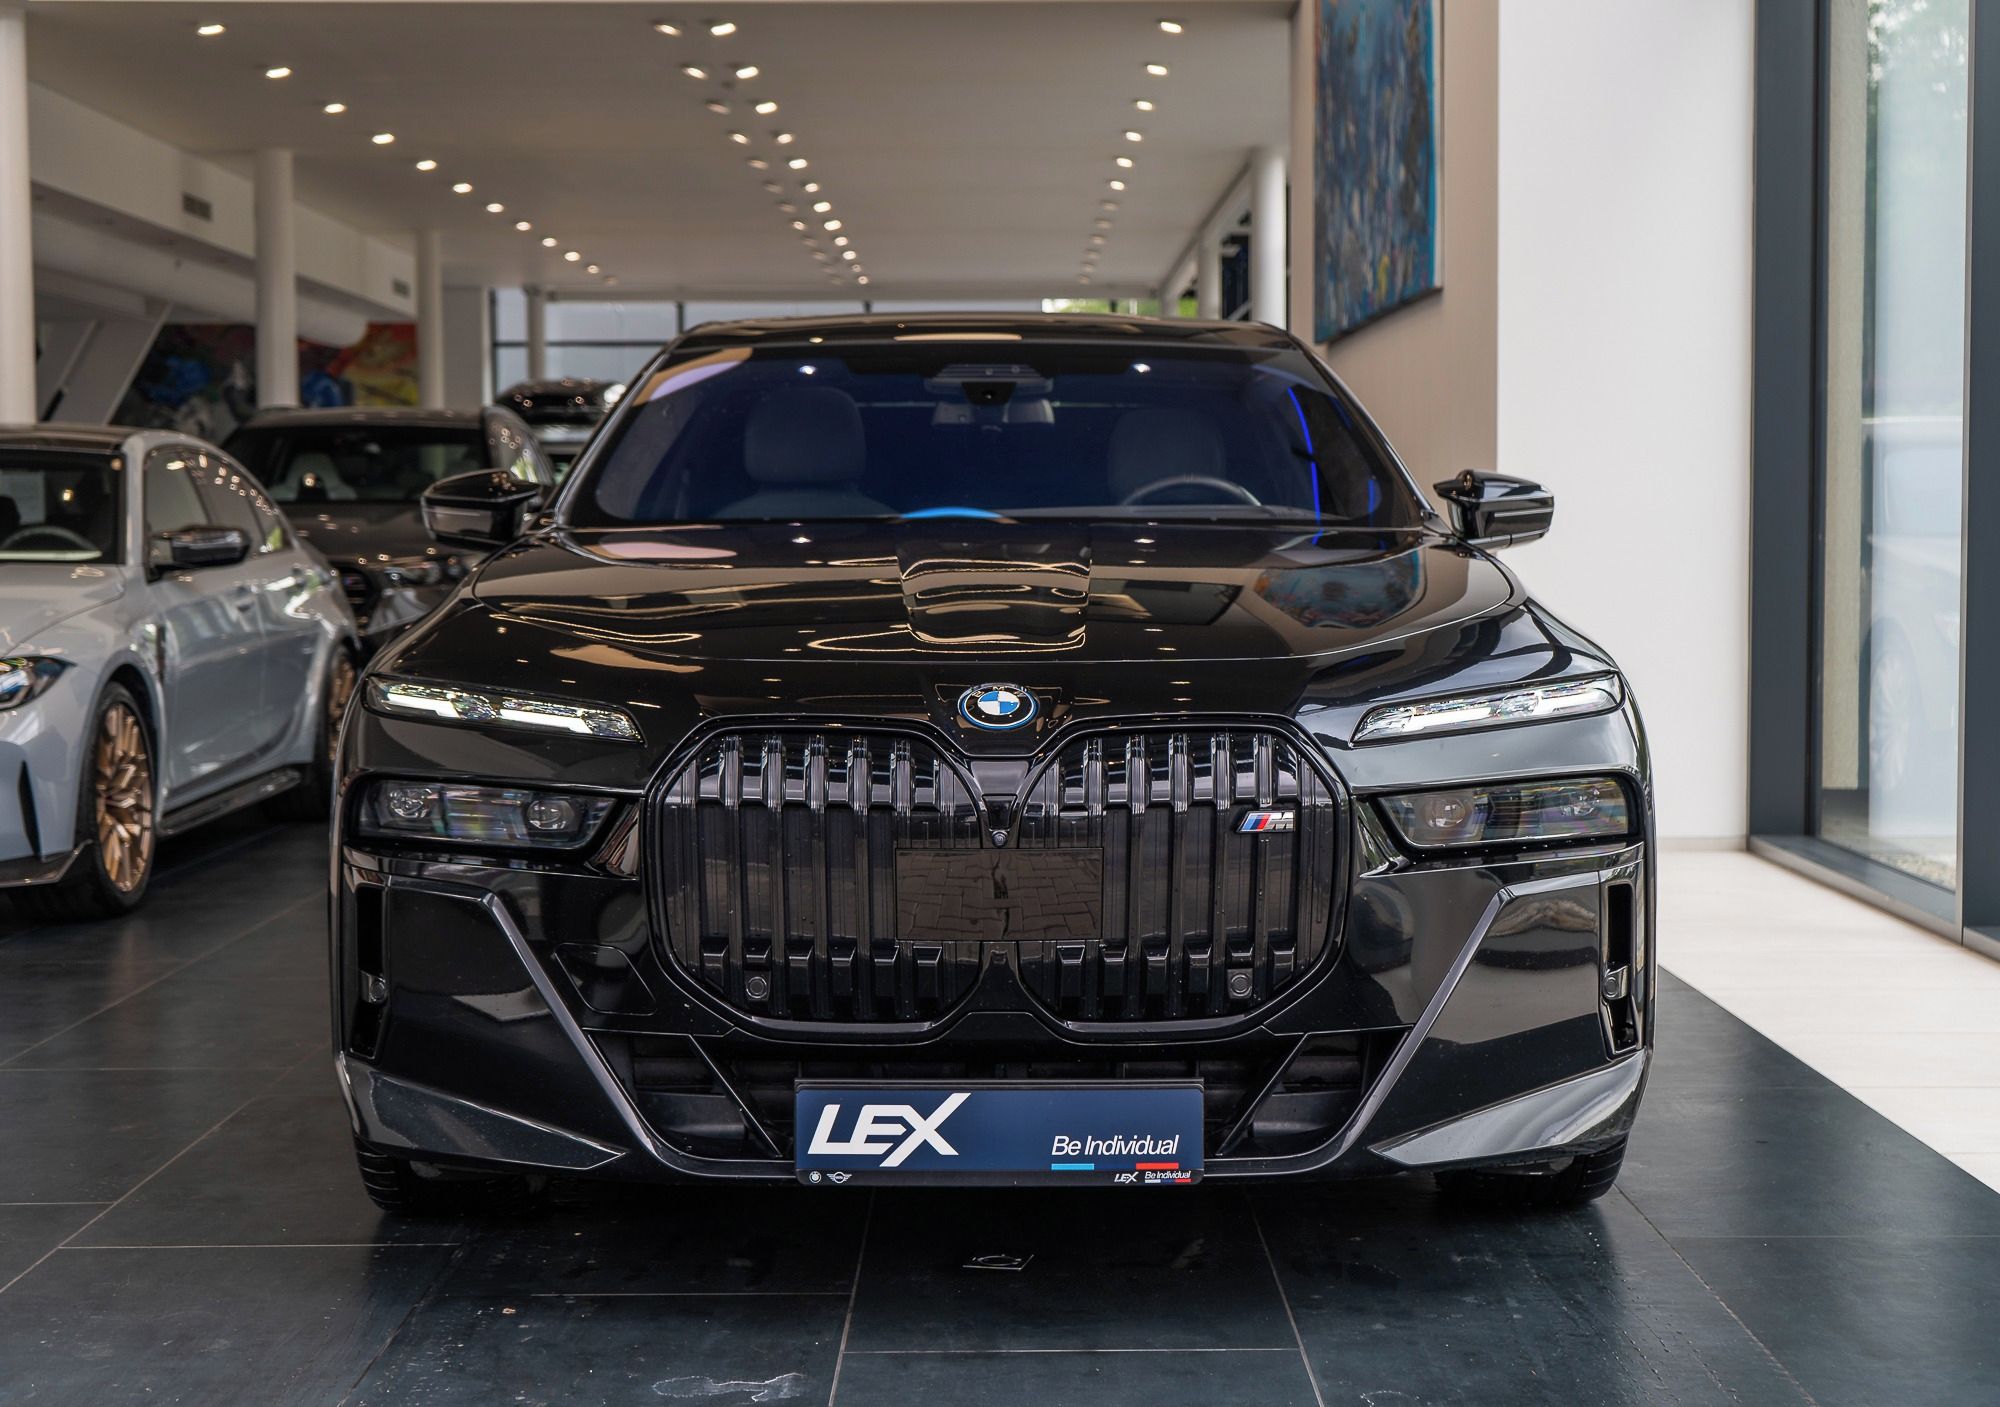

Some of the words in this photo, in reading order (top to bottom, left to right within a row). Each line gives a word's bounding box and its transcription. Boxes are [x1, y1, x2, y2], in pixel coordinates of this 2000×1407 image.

[807, 1092, 971, 1167] LEX
[1051, 1135, 1081, 1156] Be
[1084, 1134, 1180, 1156] Individual
[1114, 1171, 1139, 1184] LEX
[1144, 1170, 1156, 1179] Be
[1156, 1170, 1192, 1179] Individual
